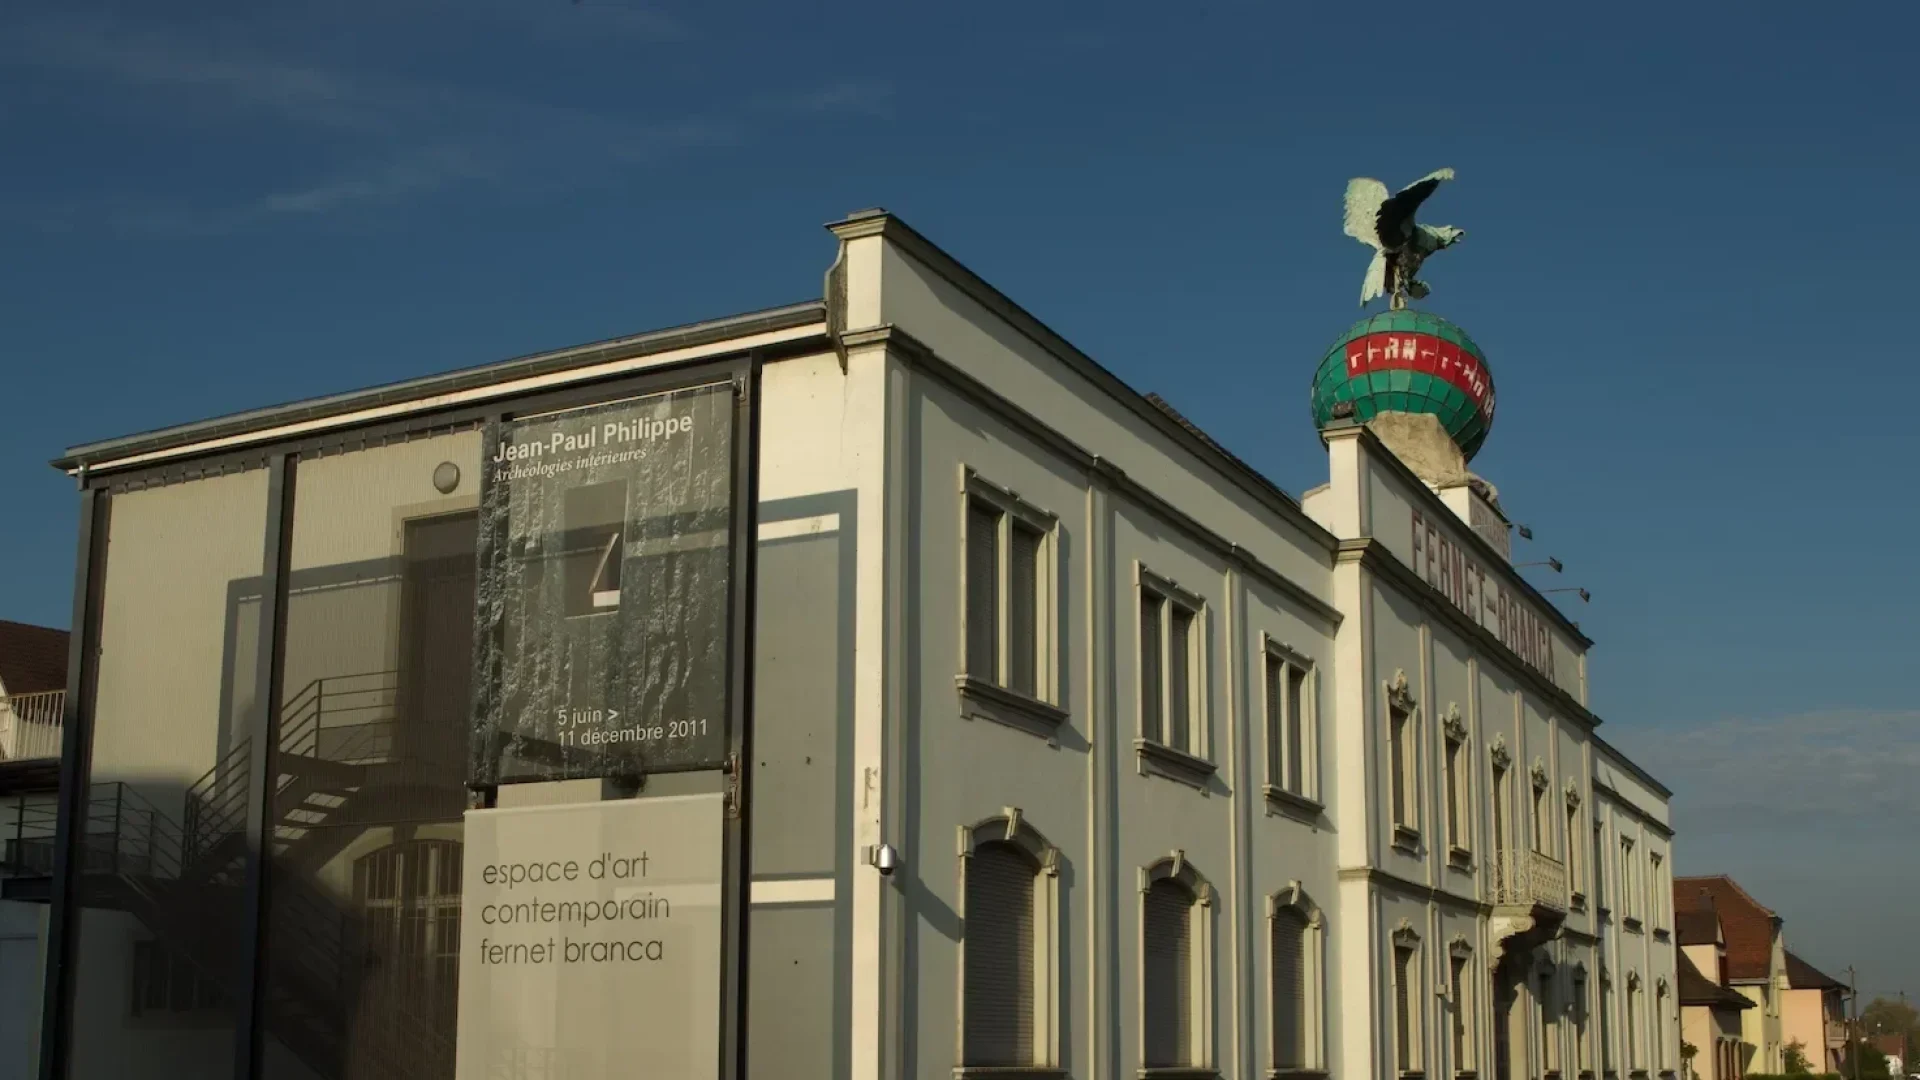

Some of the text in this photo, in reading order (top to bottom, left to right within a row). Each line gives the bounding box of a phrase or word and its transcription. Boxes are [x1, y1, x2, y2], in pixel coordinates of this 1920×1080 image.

[493, 415, 693, 463] Jean-Paul Philippe
[492, 447, 647, 483] Archéologies intérieures
[558, 709, 568, 726] 5
[572, 707, 602, 728] juin
[558, 718, 708, 747] 11 décembre 2011
[482, 851, 649, 890] espace d'art
[481, 891, 670, 927] contemporain
[480, 936, 663, 965] fernet branca
